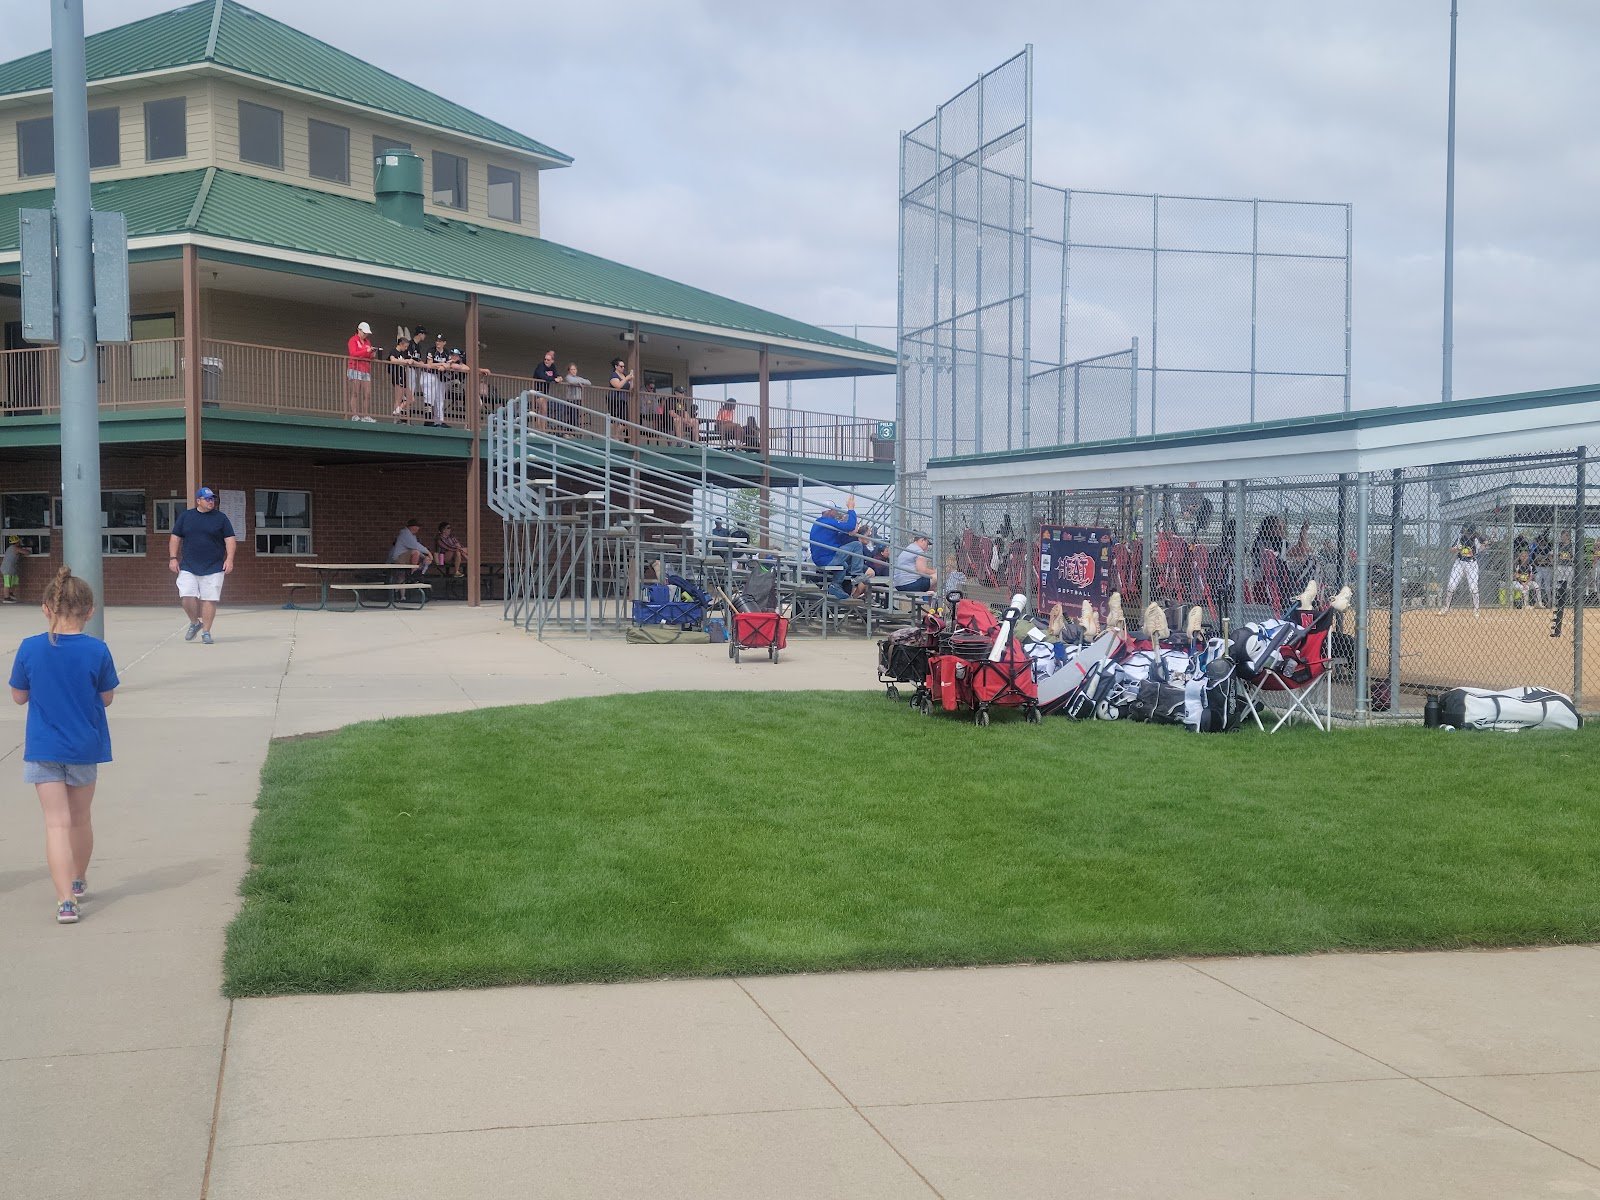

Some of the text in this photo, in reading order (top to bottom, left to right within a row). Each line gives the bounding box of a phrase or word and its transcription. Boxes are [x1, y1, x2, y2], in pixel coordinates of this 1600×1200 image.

[883, 428, 890, 437] 3
[1058, 588, 1090, 596] SOFTBALL
[1301, 613, 1316, 629] N
